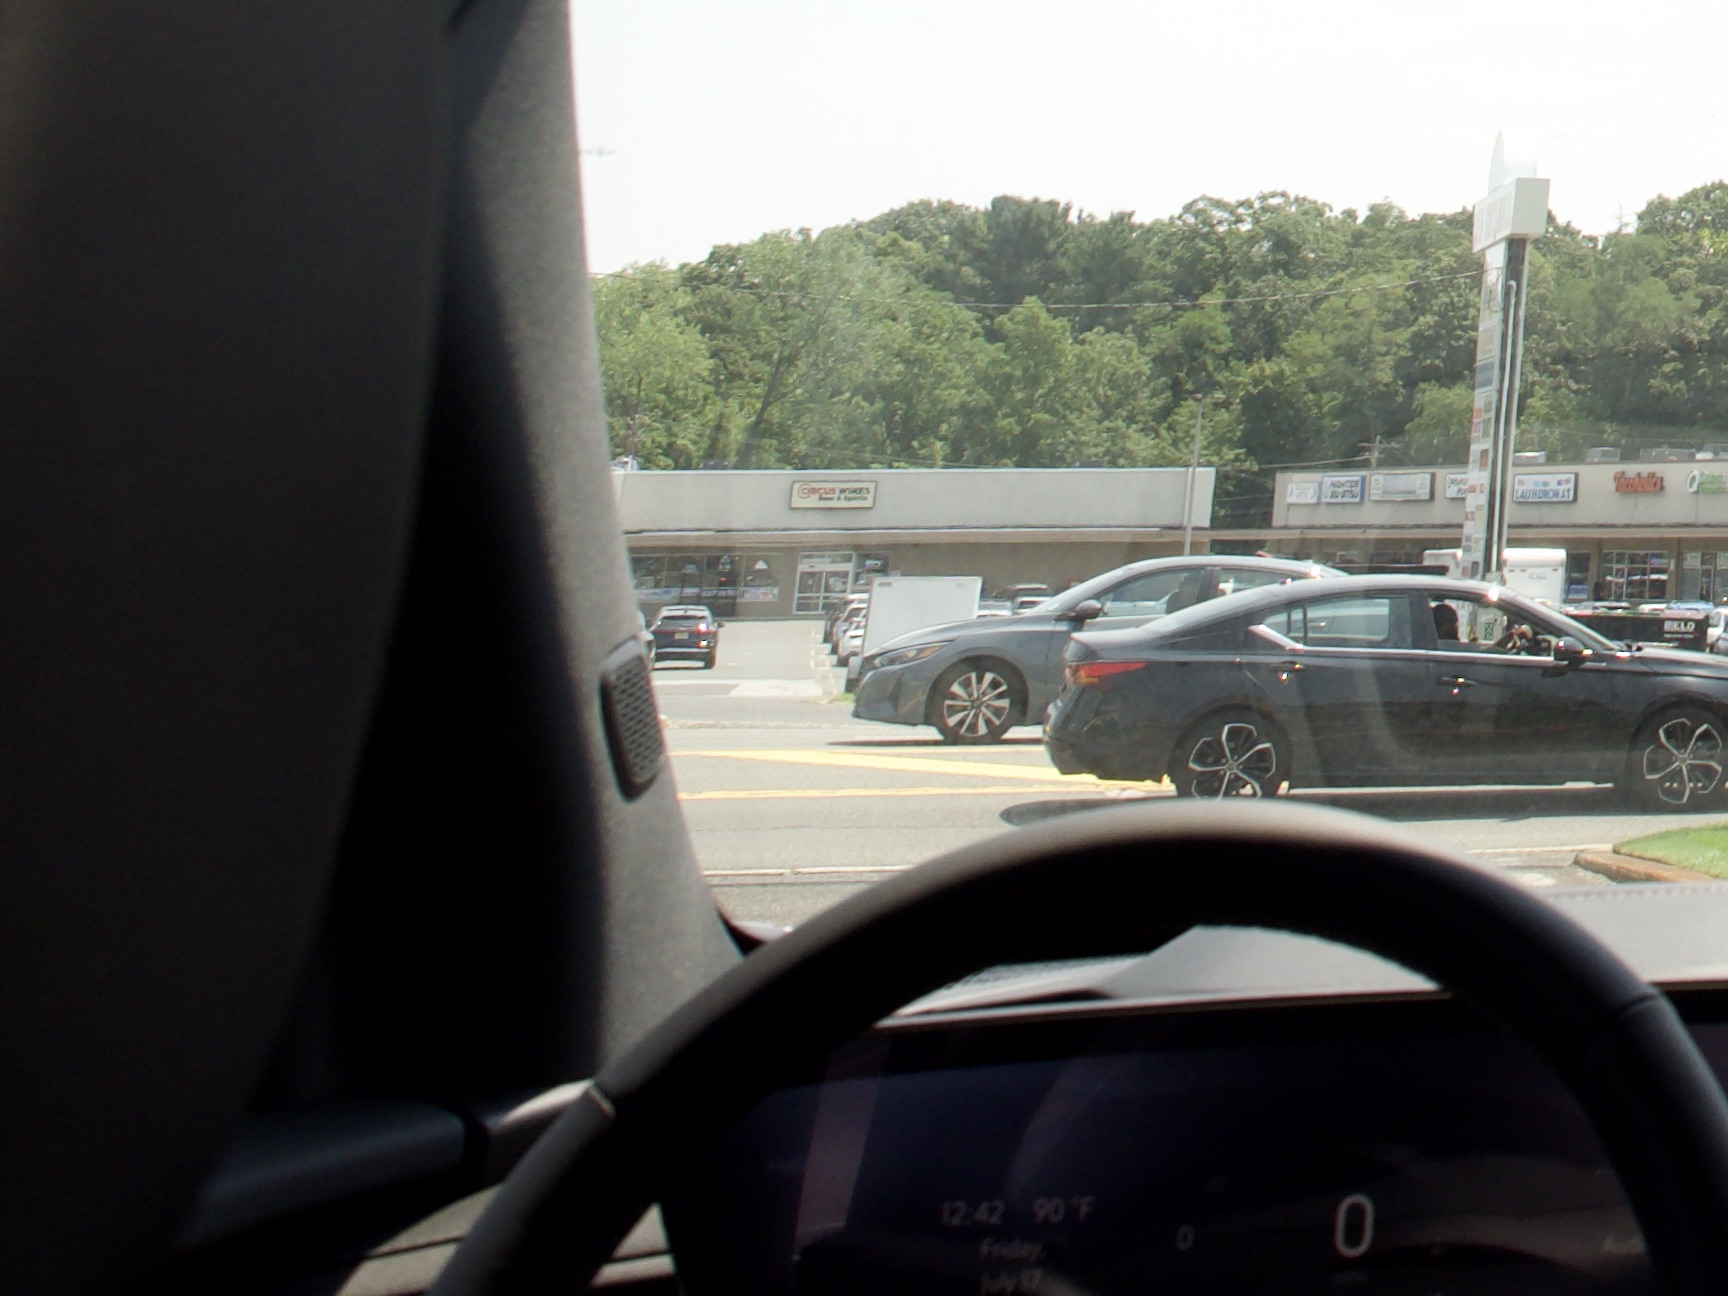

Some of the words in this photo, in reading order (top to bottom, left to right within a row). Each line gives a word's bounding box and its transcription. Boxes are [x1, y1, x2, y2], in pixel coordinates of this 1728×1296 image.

[1515, 488, 1571, 500] LAUNDROMAT
[941, 1199, 1006, 1227] 12:42
[1032, 1196, 1065, 1224] 90
[1335, 1193, 1376, 1258] 0
